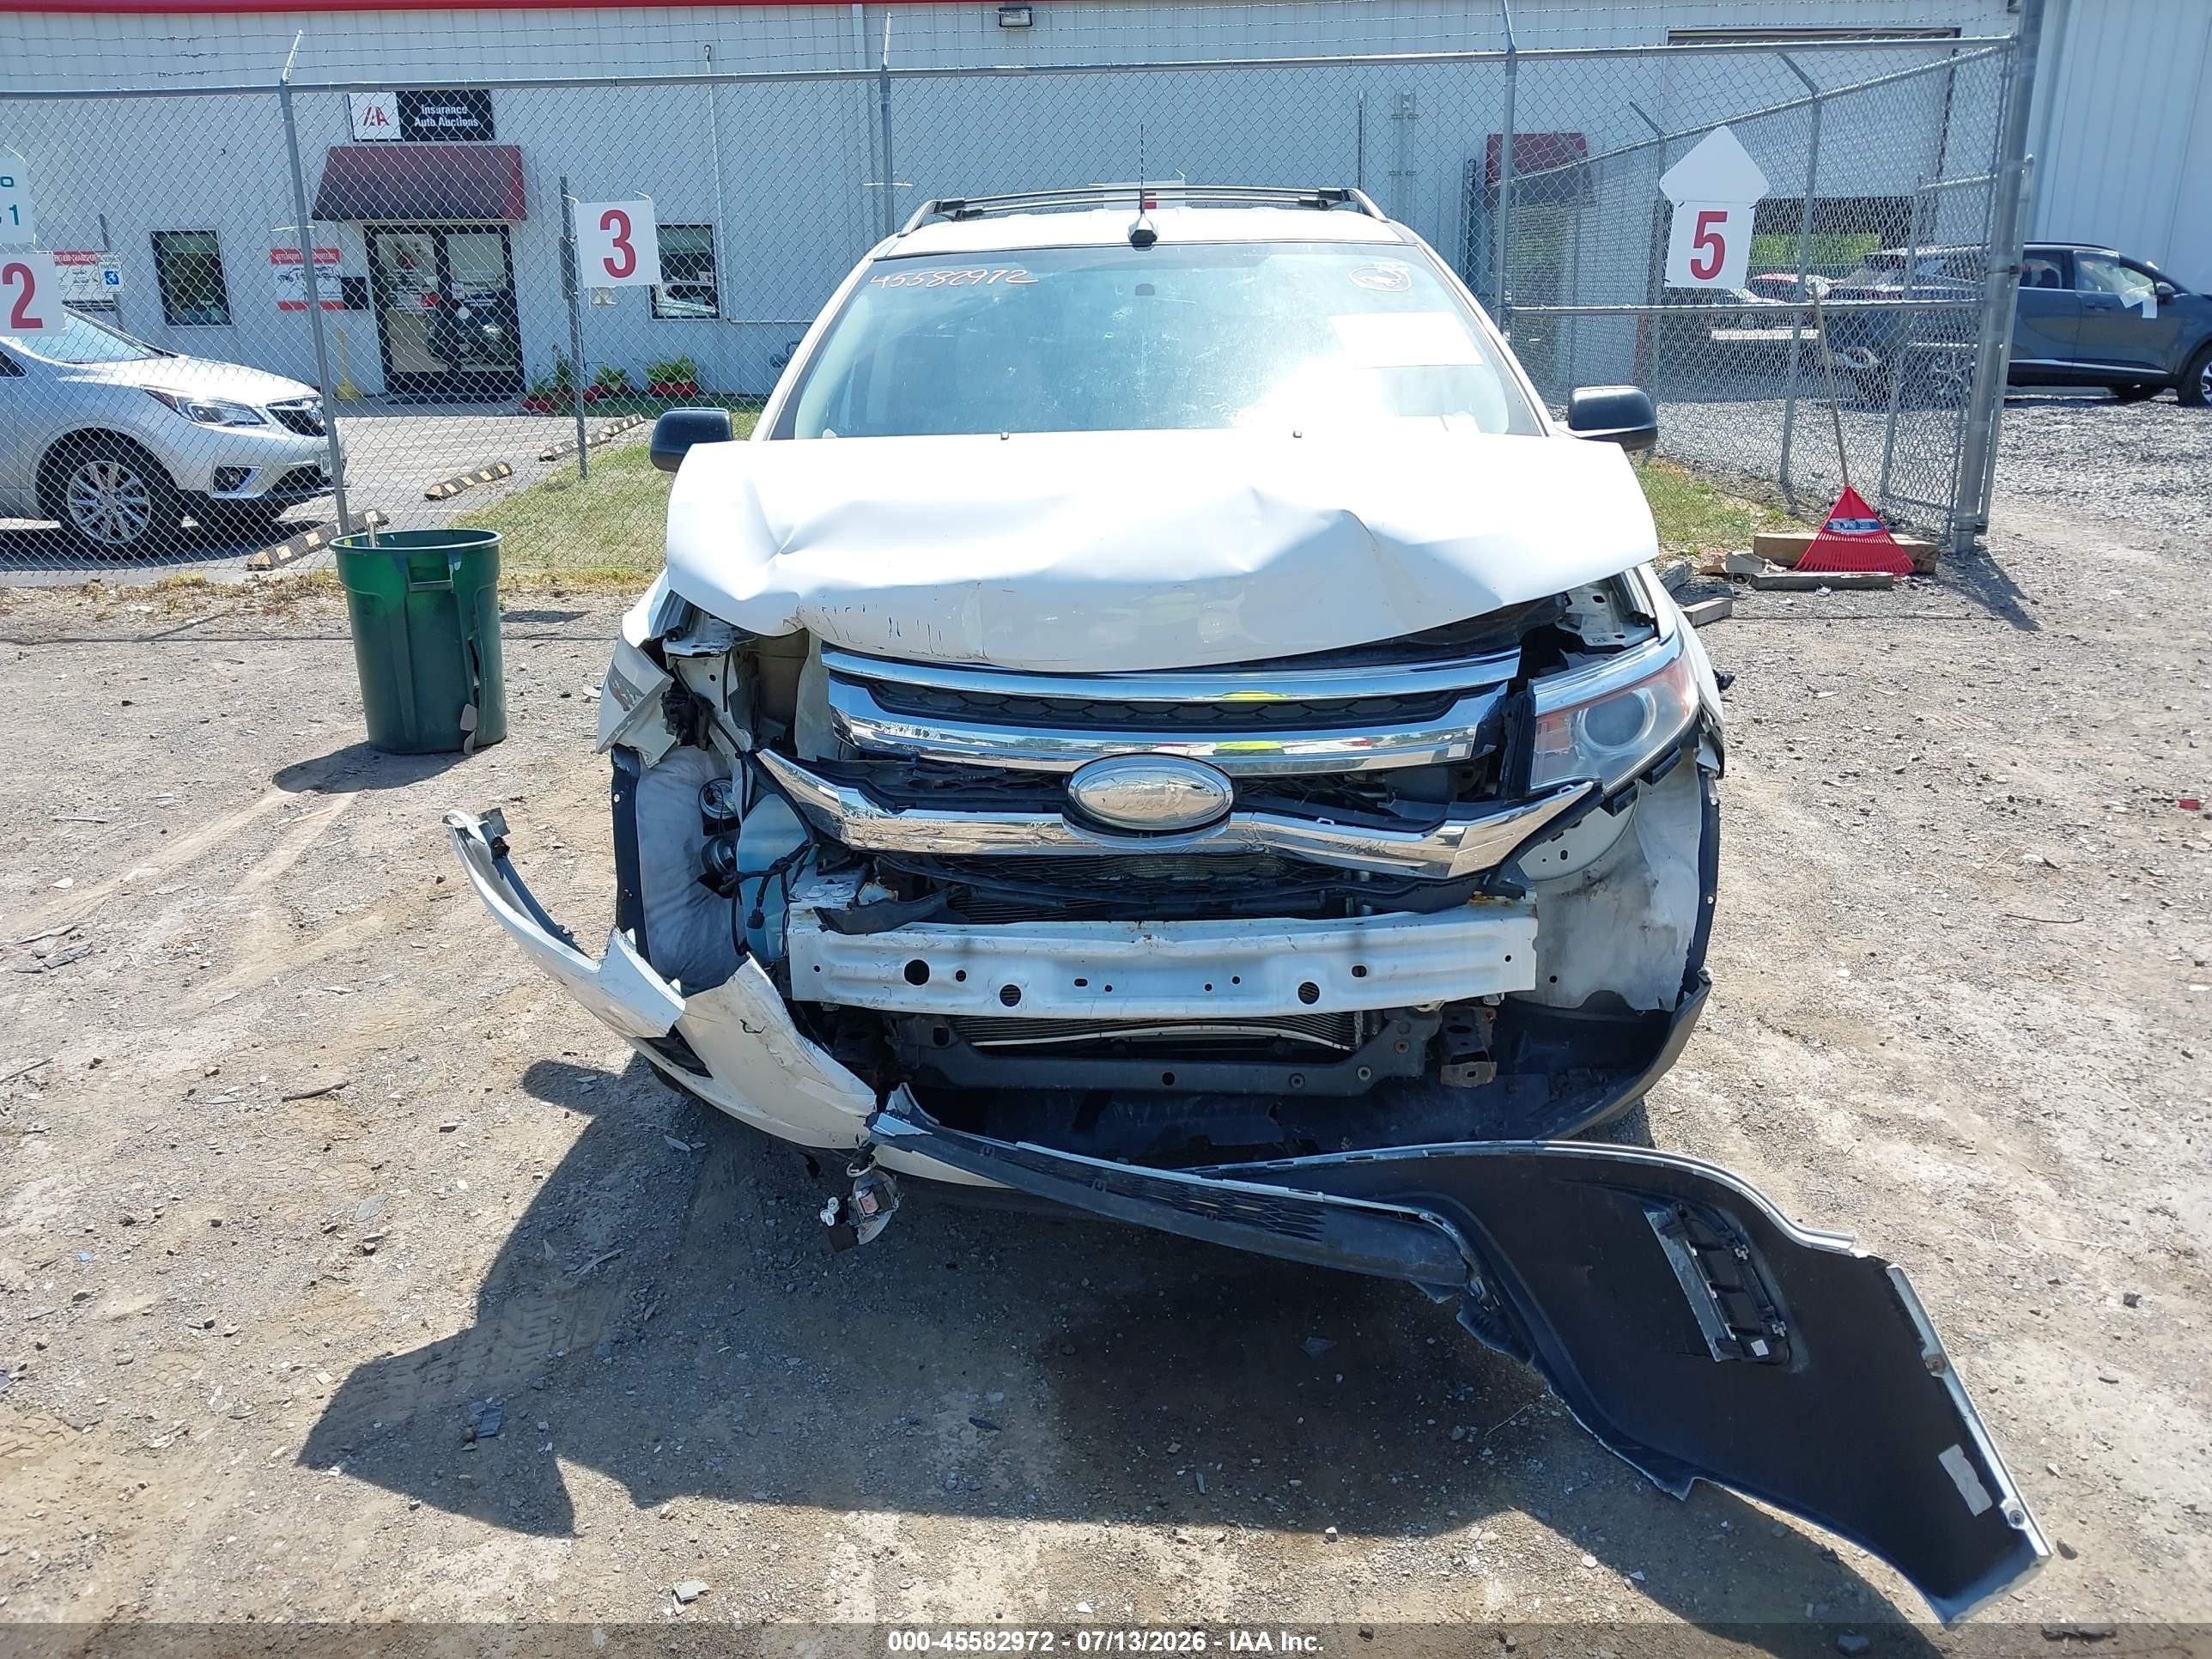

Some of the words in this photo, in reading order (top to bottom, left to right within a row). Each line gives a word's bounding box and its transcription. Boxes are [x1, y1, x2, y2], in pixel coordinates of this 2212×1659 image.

[414, 117, 435, 127] Auto
[438, 117, 478, 127] Auctions
[422, 105, 468, 115] Insurance
[599, 210, 636, 278] 3
[1691, 211, 1728, 280] 5
[2, 263, 44, 329] 2
